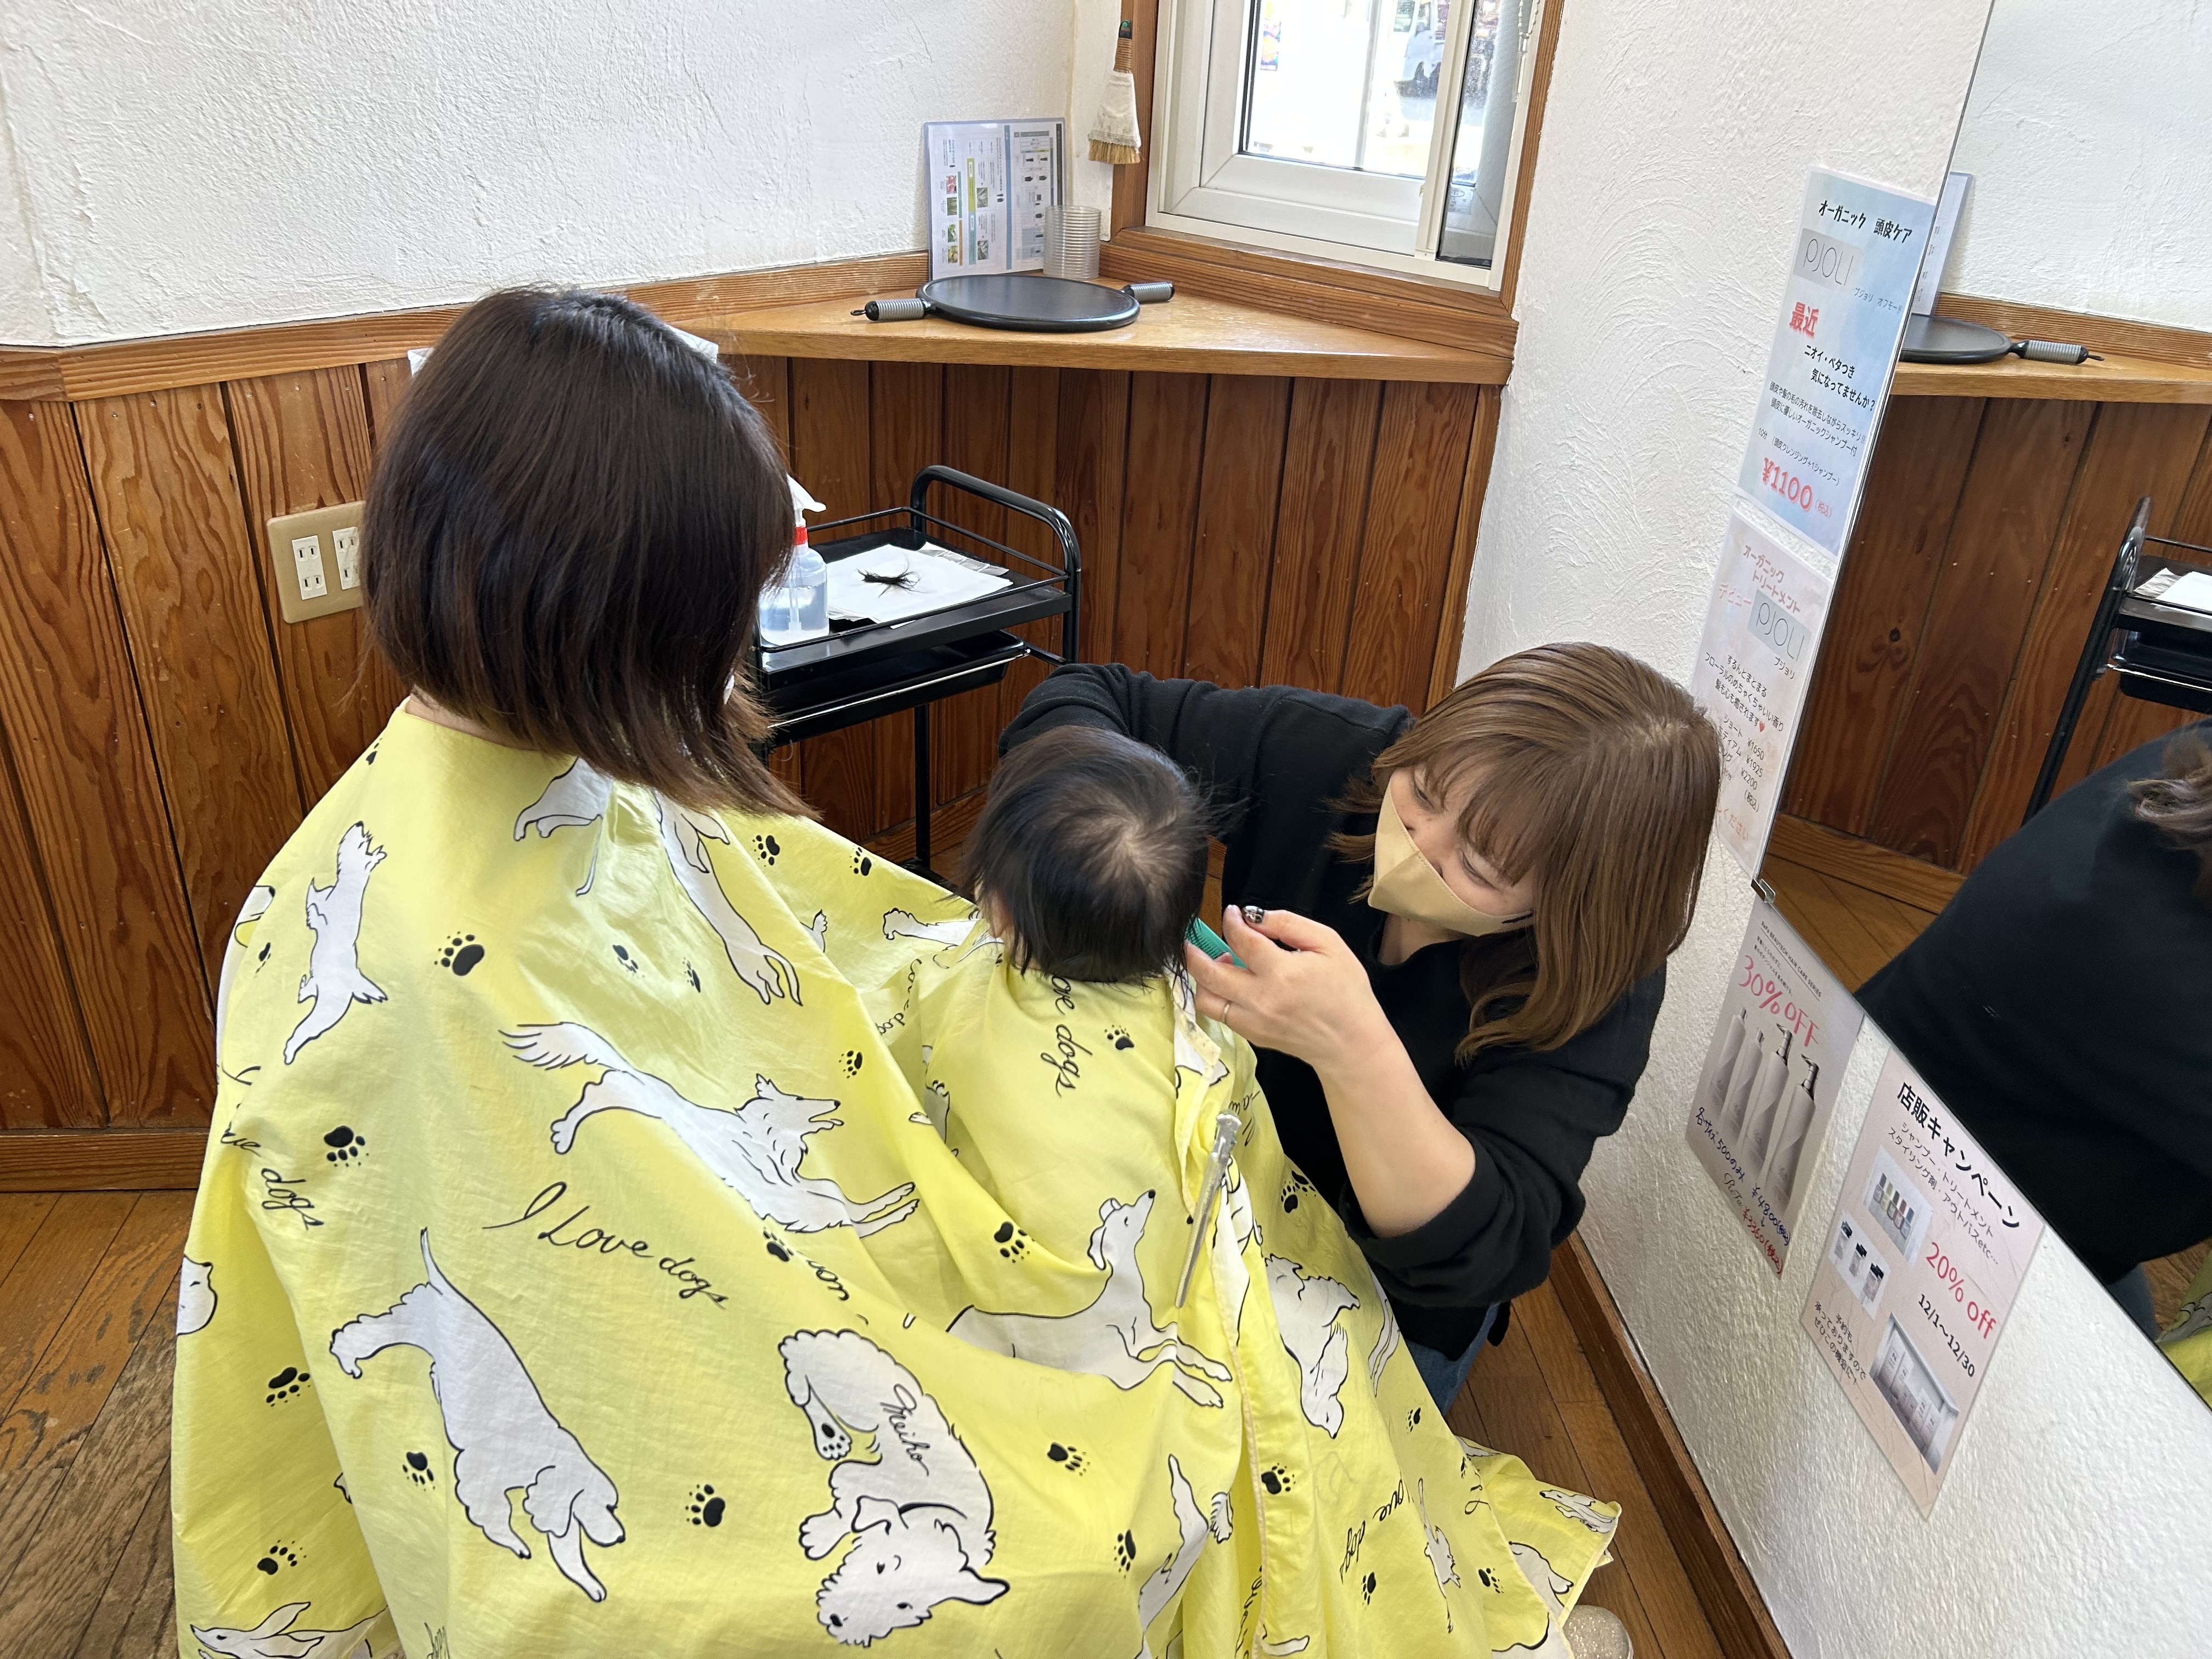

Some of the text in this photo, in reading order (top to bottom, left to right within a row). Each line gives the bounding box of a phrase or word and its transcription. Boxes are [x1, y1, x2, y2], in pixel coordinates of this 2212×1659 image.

[1818, 200, 1913, 244] オーガニック 頭皮ケア
[1789, 302, 1819, 338] 最近
[1743, 545, 1785, 584] オーガニック
[1752, 571, 1801, 613] トリートメント
[1723, 714, 1743, 738] ショート
[1040, 1024, 1093, 1098] dogs
[1897, 1082, 2019, 1228] 店販キャンペーン
[261, 1167, 325, 1231] dogs
[1926, 1242, 1964, 1303] 20%
